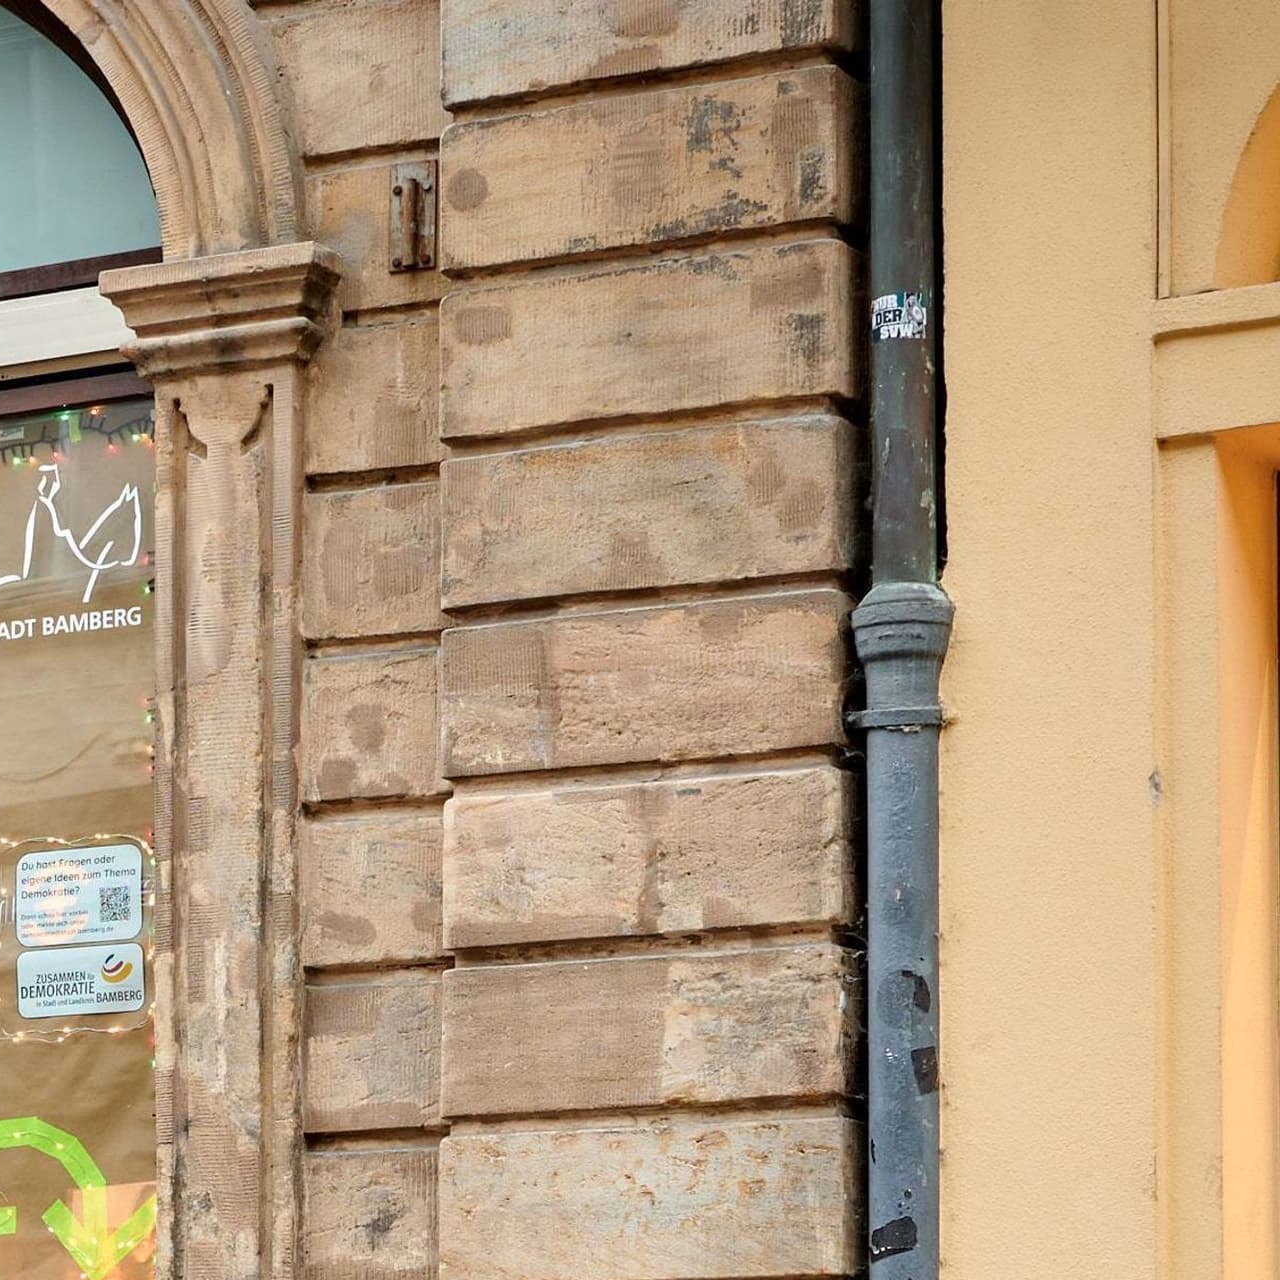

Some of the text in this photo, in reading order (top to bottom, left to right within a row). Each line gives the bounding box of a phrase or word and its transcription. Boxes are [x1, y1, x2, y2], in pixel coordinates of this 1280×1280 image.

[875, 308, 903, 326] DER
[41, 606, 142, 636] BAMBERG
[21, 861, 34, 871] Du
[94, 855, 116, 865] oder
[21, 867, 136, 888] eigene Ideen zum Thema
[21, 886, 80, 900] Demokratie?
[36, 971, 86, 984] ZUSAMMEN
[20, 981, 95, 999] DEMOKRATIE
[96, 990, 143, 1003] BAMBERG
